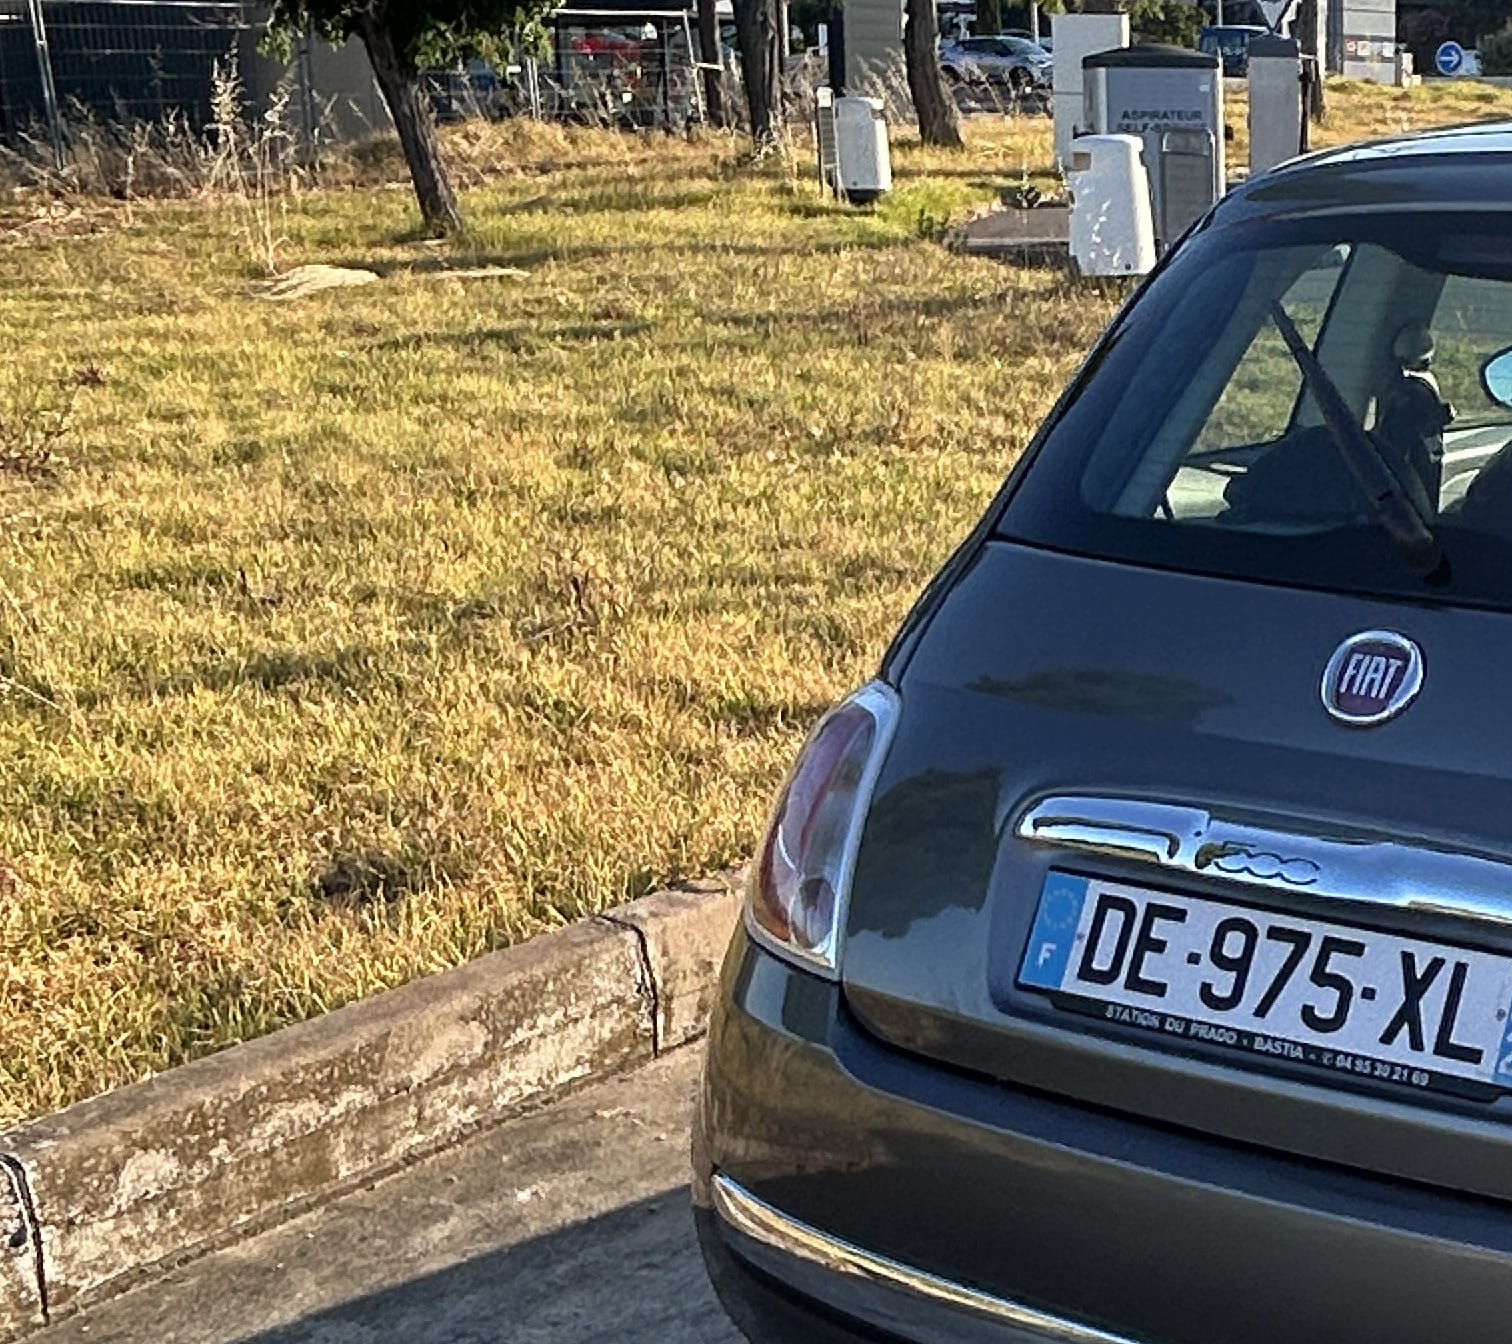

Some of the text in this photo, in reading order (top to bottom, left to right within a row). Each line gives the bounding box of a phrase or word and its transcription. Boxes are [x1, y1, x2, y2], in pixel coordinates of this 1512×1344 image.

[1122, 110, 1202, 120] ASPIRATEUR
[1339, 653, 1402, 699] FIAT
[1213, 840, 1321, 886] 500
[1036, 943, 1056, 967] F
[1076, 892, 1485, 1066] DE-975-XL
[1104, 1004, 1160, 1029] STATION
[1164, 1016, 1186, 1034] DU
[1189, 1023, 1238, 1045] PRADO
[1254, 1036, 1304, 1060] BASTIA
